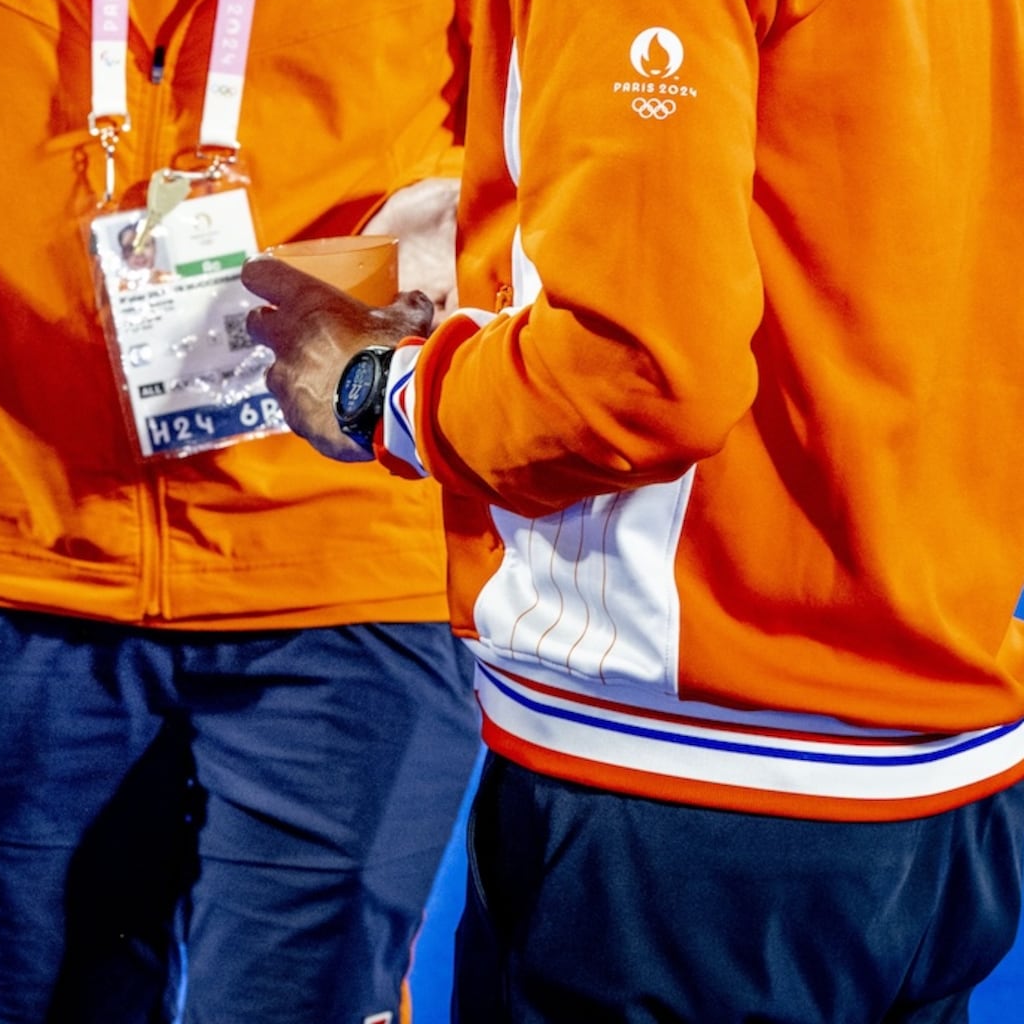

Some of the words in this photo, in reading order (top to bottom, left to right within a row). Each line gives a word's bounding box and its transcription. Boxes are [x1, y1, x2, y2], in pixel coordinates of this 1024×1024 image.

[221, 4, 244, 65] 2024
[613, 82, 655, 93] PARIS
[658, 83, 697, 97] 2024
[140, 383, 164, 397] ALL
[147, 413, 216, 446] H24
